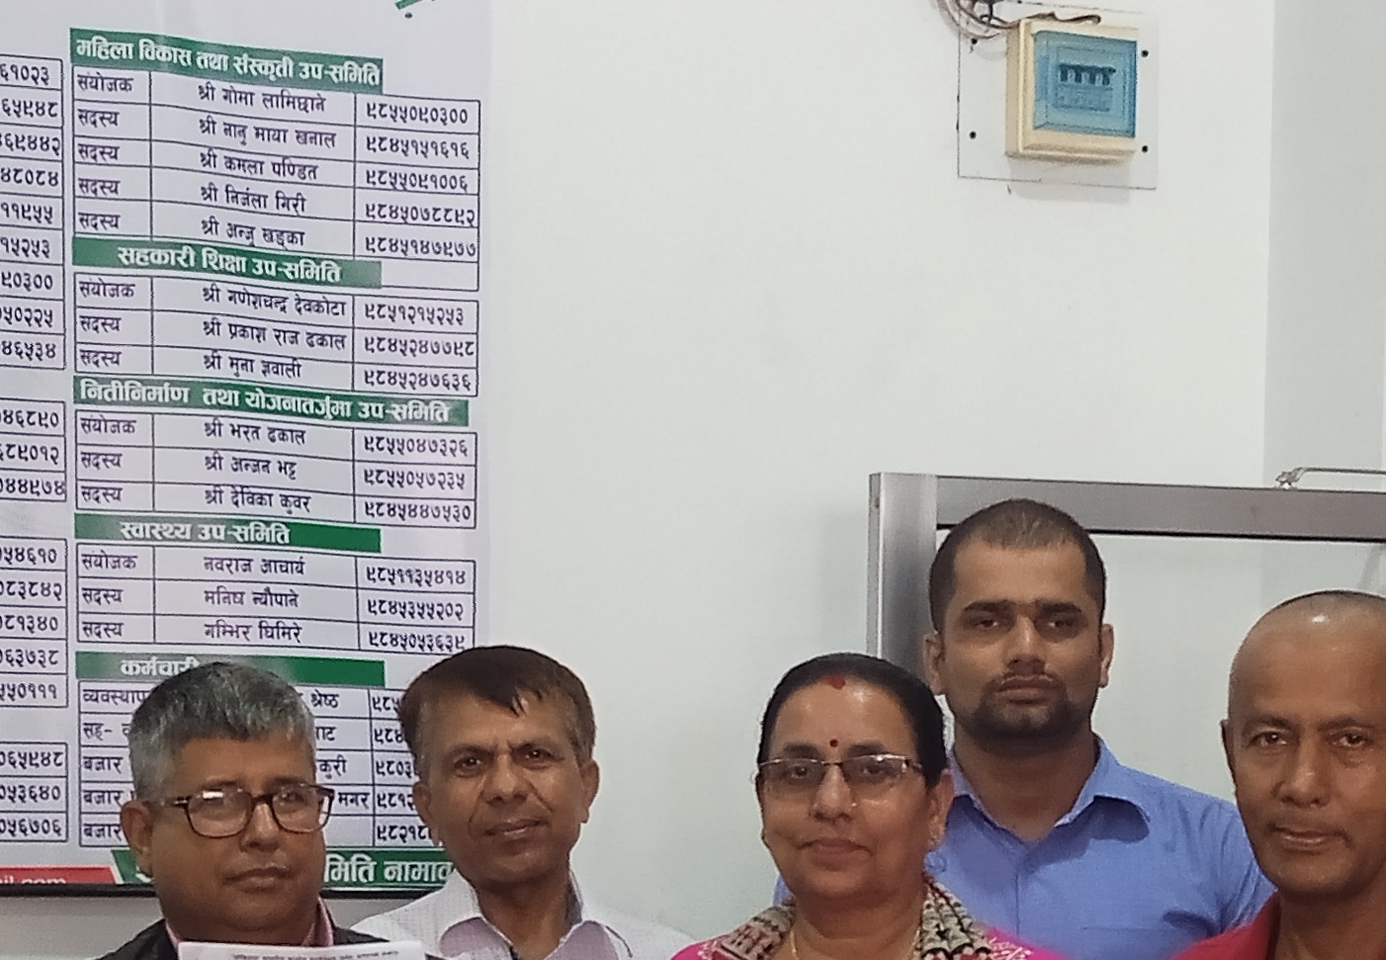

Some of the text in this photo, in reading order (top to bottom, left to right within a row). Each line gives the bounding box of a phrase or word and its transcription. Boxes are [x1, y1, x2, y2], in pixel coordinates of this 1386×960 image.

[76, 37, 134, 60] महिला
[139, 41, 192, 66] विकास
[196, 51, 229, 71] तथा
[299, 61, 380, 86] उप-समिति
[77, 71, 327, 114] संयोजक श्री गोमा लामिछाने
[77, 143, 319, 180] सदस्य श्री कमला पण्डित
[77, 212, 121, 231] सदस्य
[201, 217, 220, 238] श्री
[262, 226, 306, 248] खड्का
[118, 247, 339, 282] सहकारी शिक्षा उप-समिति
[79, 277, 346, 318] संयोजक श्री गणेशचन्द्र देवकोटा
[79, 315, 346, 351] सदस्य श्री प्रकाश राज ढकाल
[202, 388, 239, 408] तथा
[358, 400, 450, 422] उप-समिति
[79, 414, 306, 446] संयोजक श्री भरत ढकाल
[80, 451, 123, 470] सदस्य
[205, 451, 224, 471] श्री
[120, 519, 291, 544] स्वास्थ्य उप-समिति
[81, 549, 306, 575] संयोजक नवराज आचार्य
